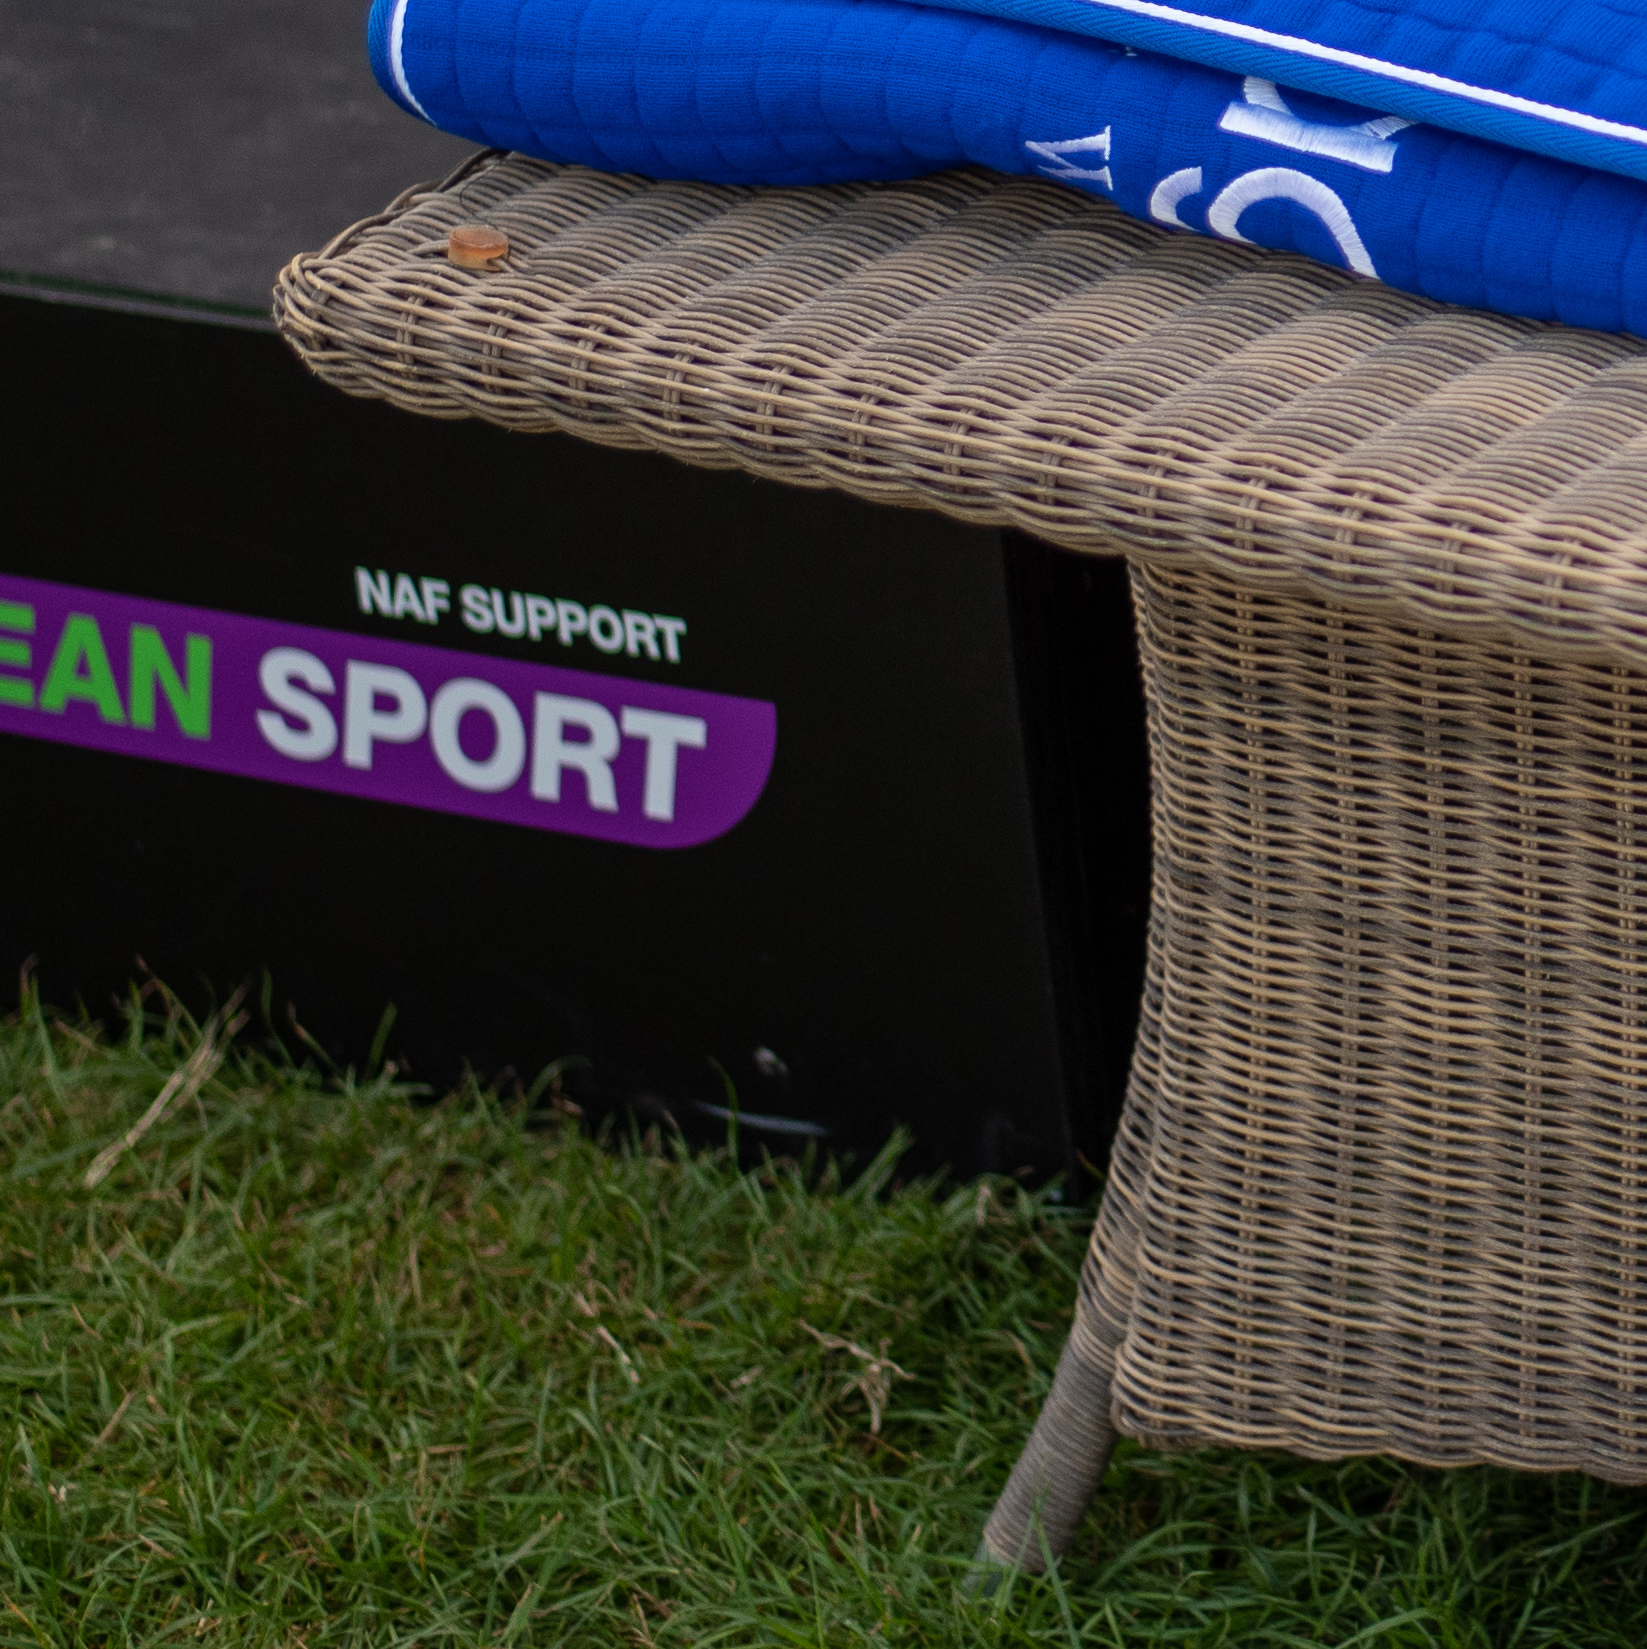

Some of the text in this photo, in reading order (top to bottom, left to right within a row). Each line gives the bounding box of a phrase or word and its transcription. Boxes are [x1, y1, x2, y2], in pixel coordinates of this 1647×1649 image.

[355, 567, 687, 663] NAF SUPPORT
[0, 598, 707, 824] EAN SPORT
